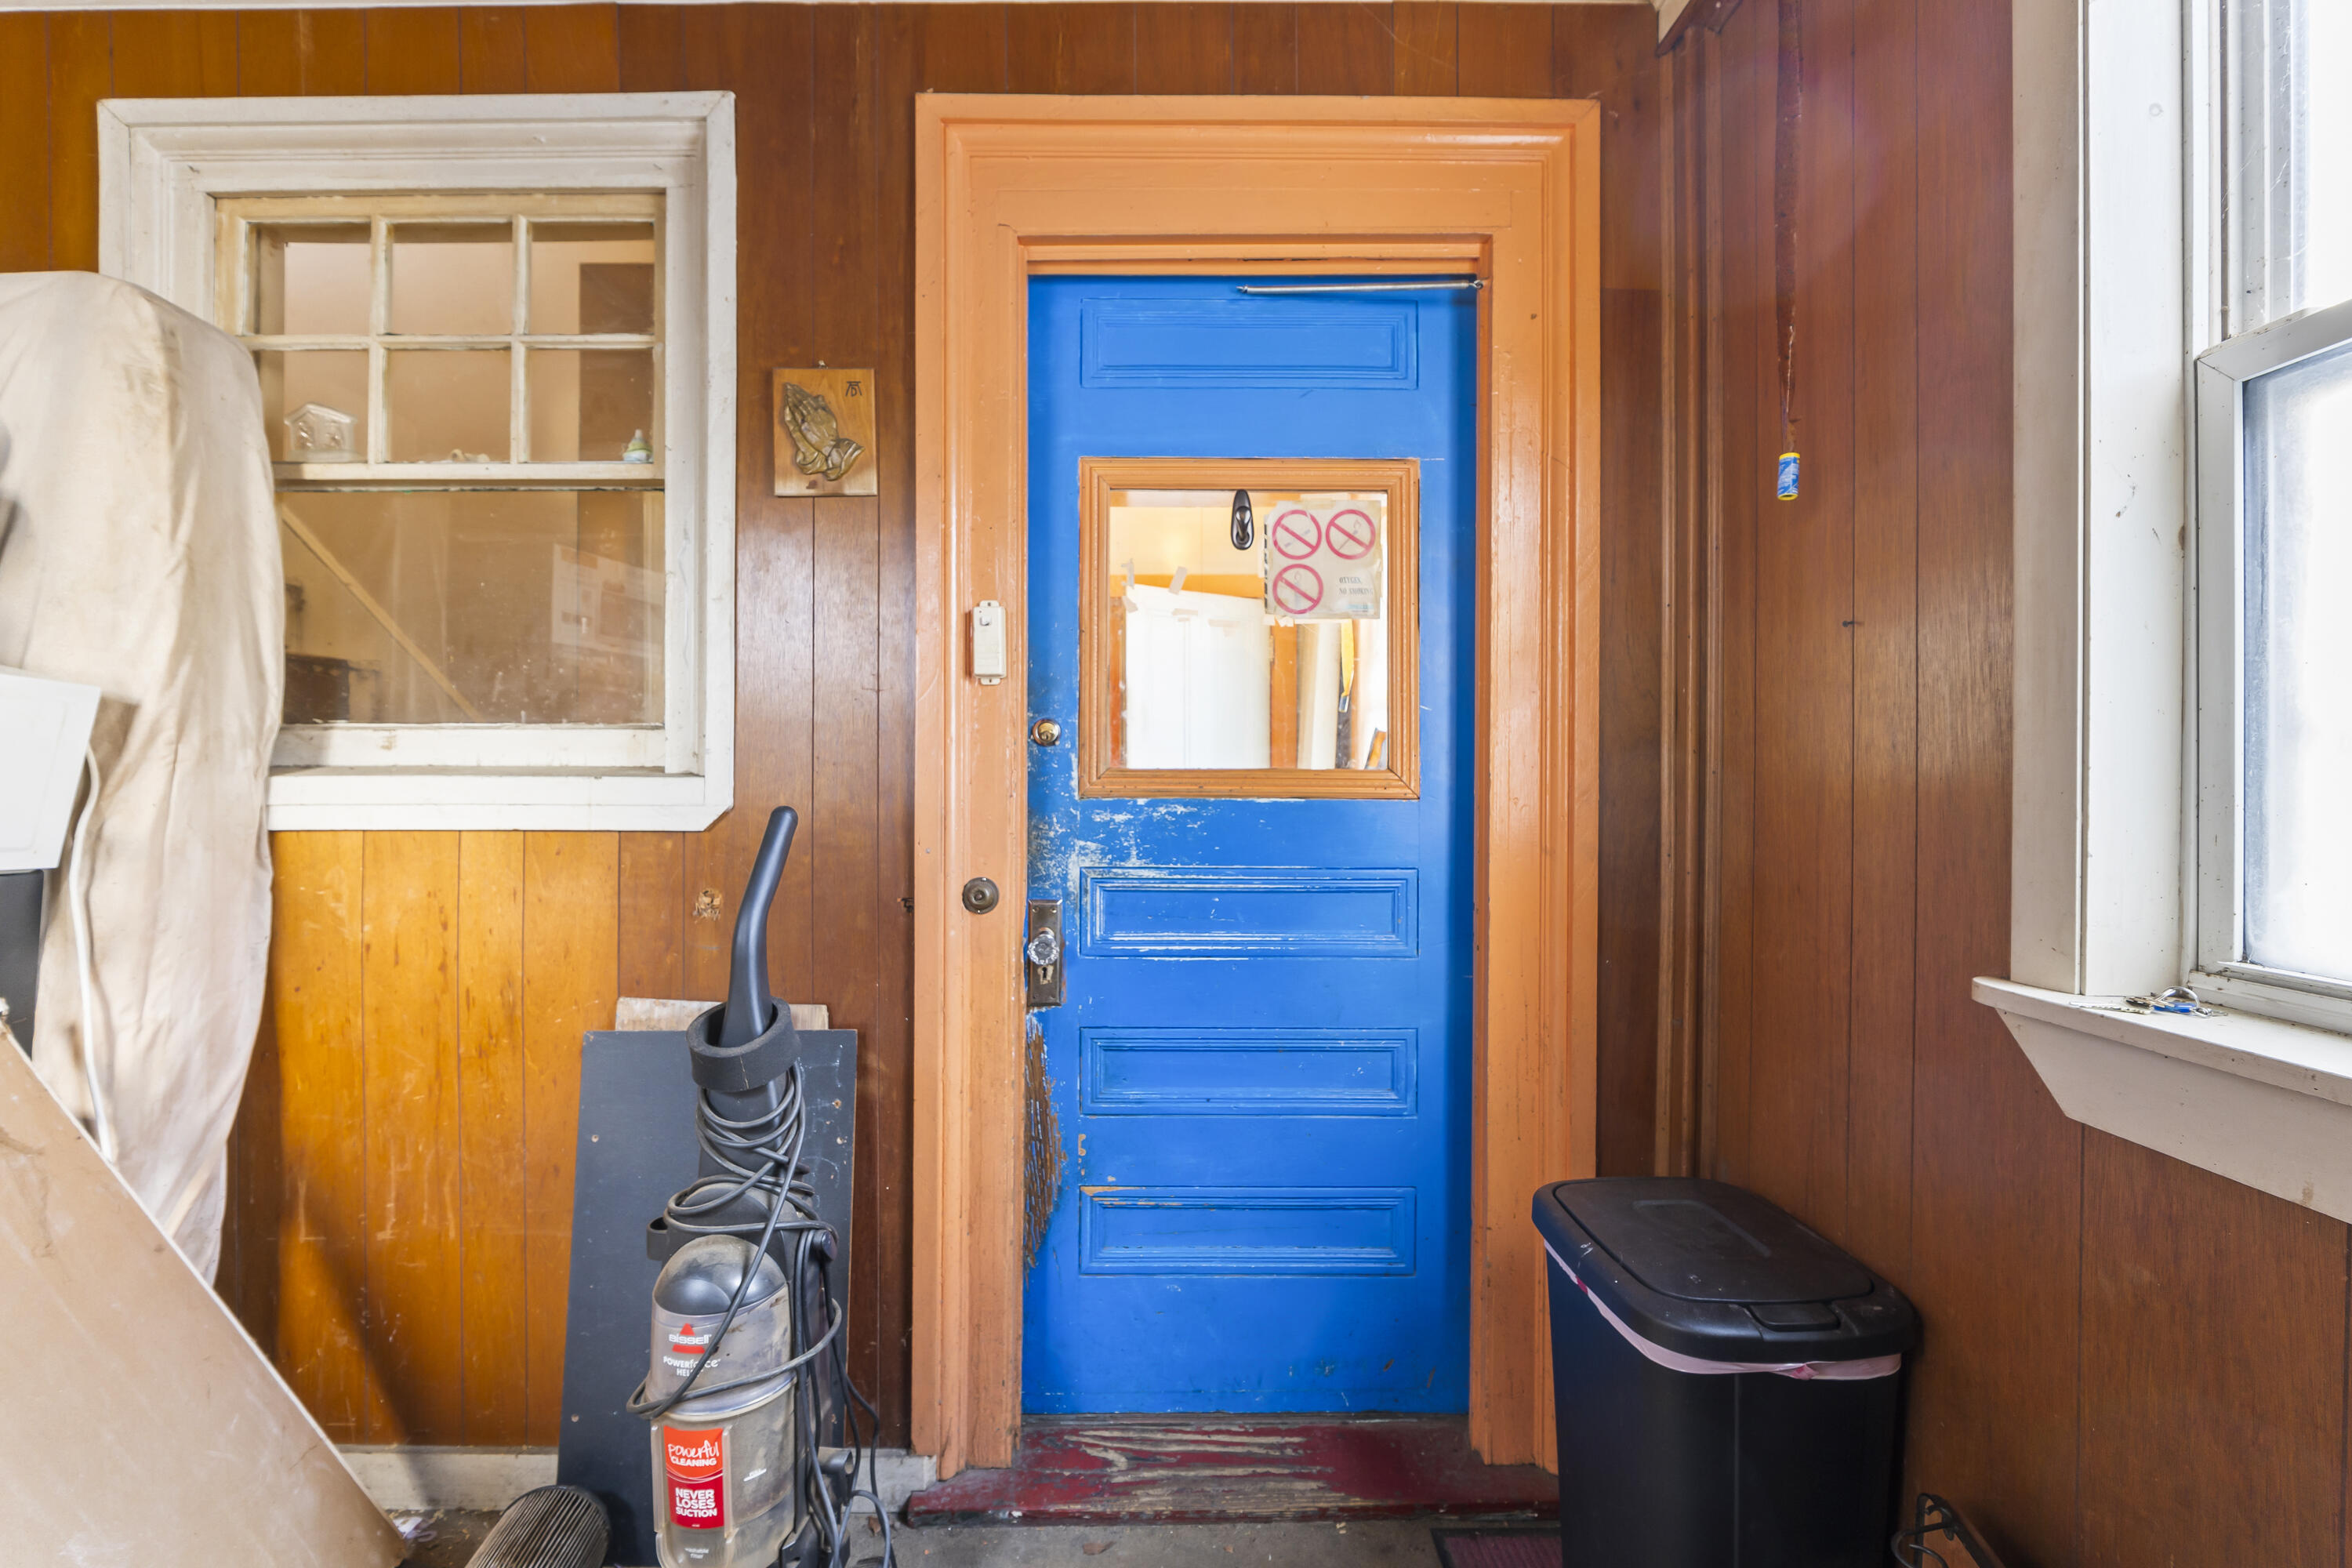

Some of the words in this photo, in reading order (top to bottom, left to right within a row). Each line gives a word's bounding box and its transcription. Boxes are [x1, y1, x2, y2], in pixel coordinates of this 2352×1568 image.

[670, 1457, 717, 1467] CLEANING
[675, 1487, 714, 1499] NEVER
[676, 1497, 716, 1509] LOSES
[675, 1506, 717, 1518] SUCTION
